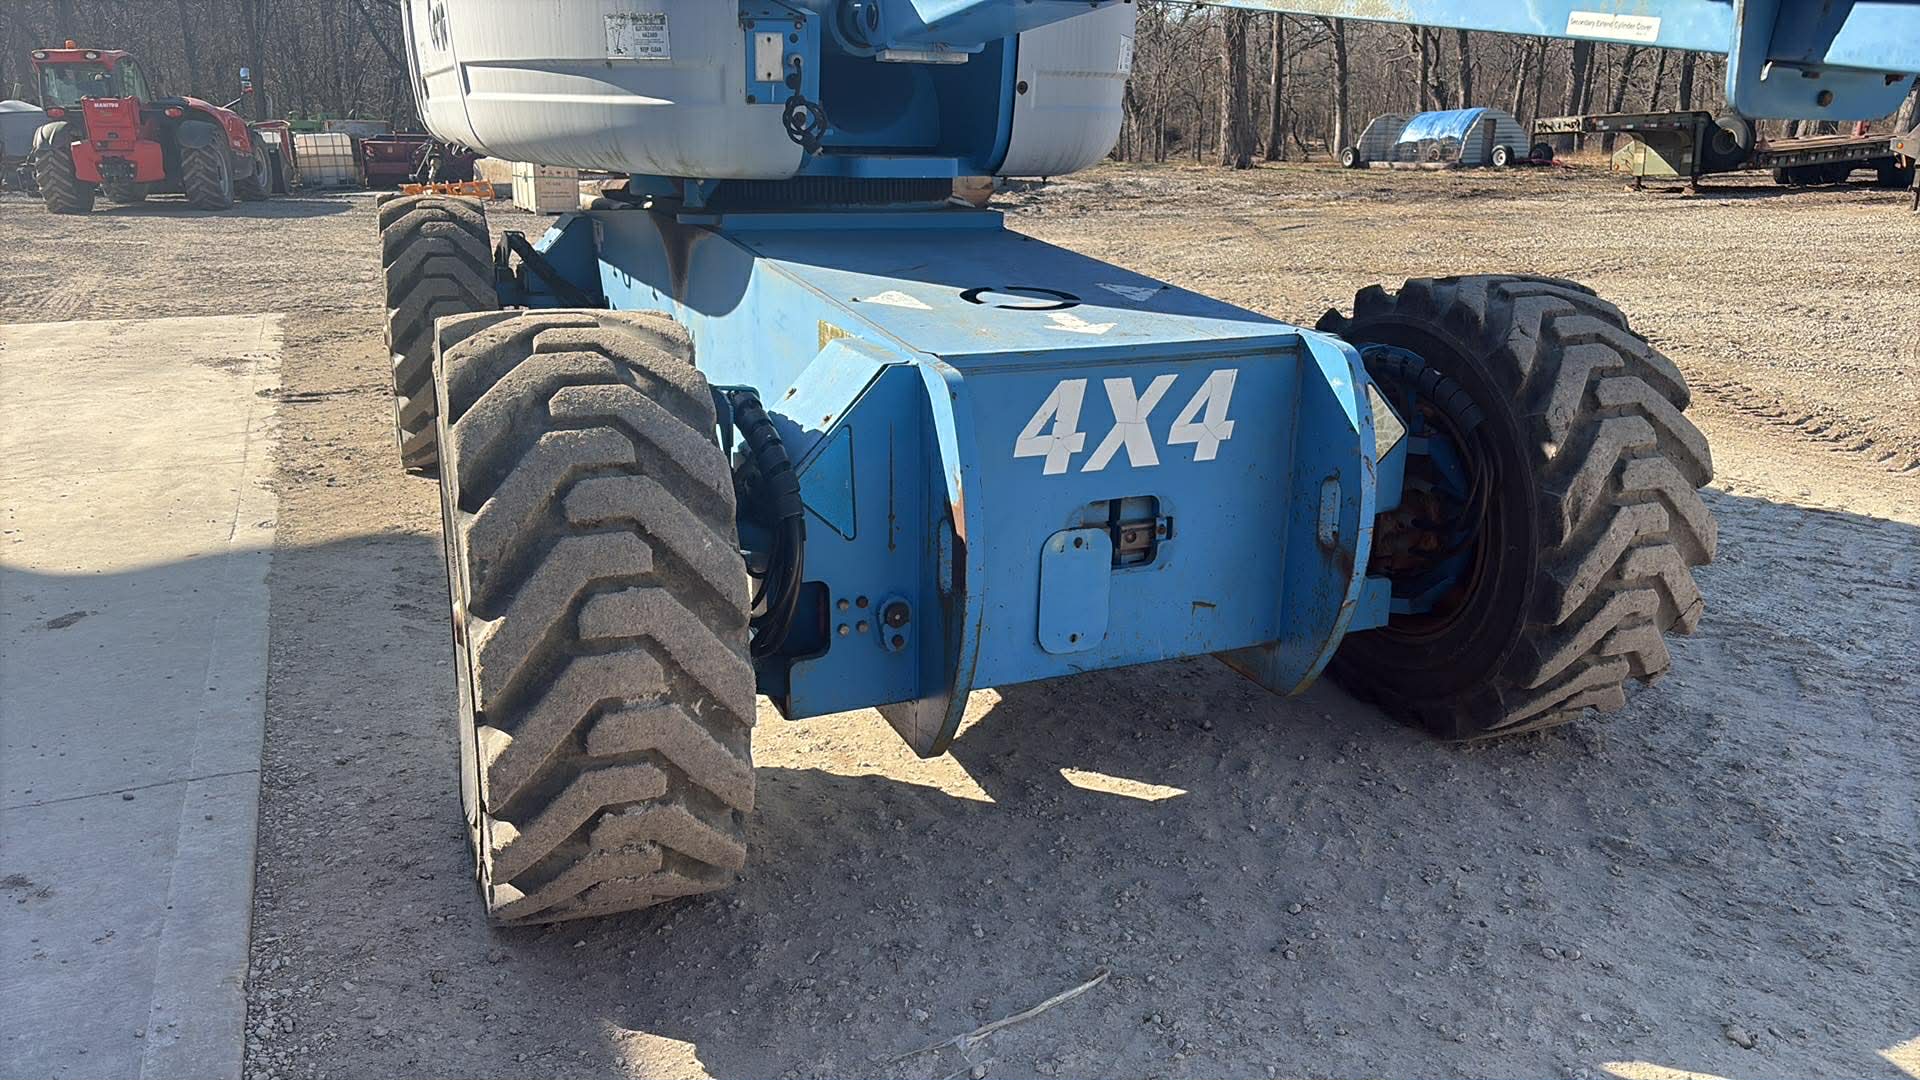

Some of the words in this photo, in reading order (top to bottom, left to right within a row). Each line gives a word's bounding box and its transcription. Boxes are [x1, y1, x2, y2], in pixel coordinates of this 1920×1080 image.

[1570, 18, 1595, 28] Secondary
[1595, 19, 1614, 28] Extend
[1614, 20, 1635, 30] Cylinder
[1636, 22, 1652, 32] Cover
[1013, 368, 1239, 476] 4X4
